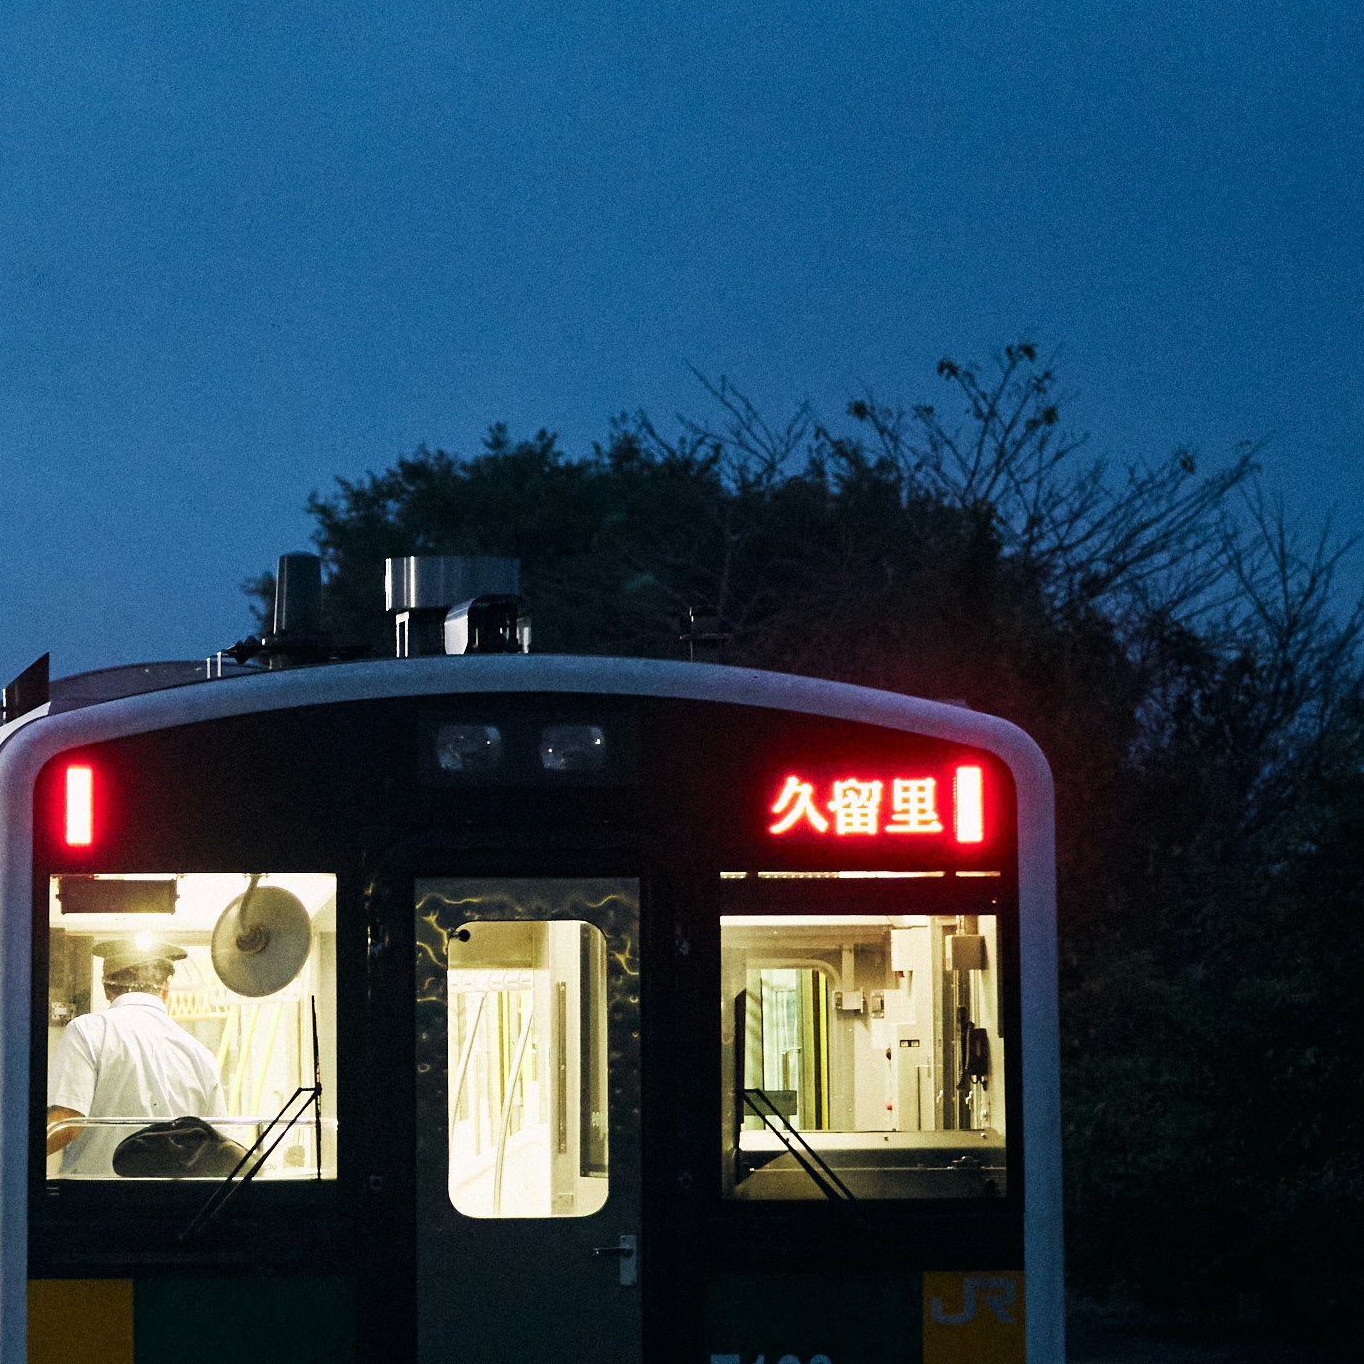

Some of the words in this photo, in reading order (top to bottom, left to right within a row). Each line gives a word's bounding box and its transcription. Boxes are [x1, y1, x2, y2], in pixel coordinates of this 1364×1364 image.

[769, 775, 943, 835] 久留里
[930, 1277, 1016, 1325] JR
